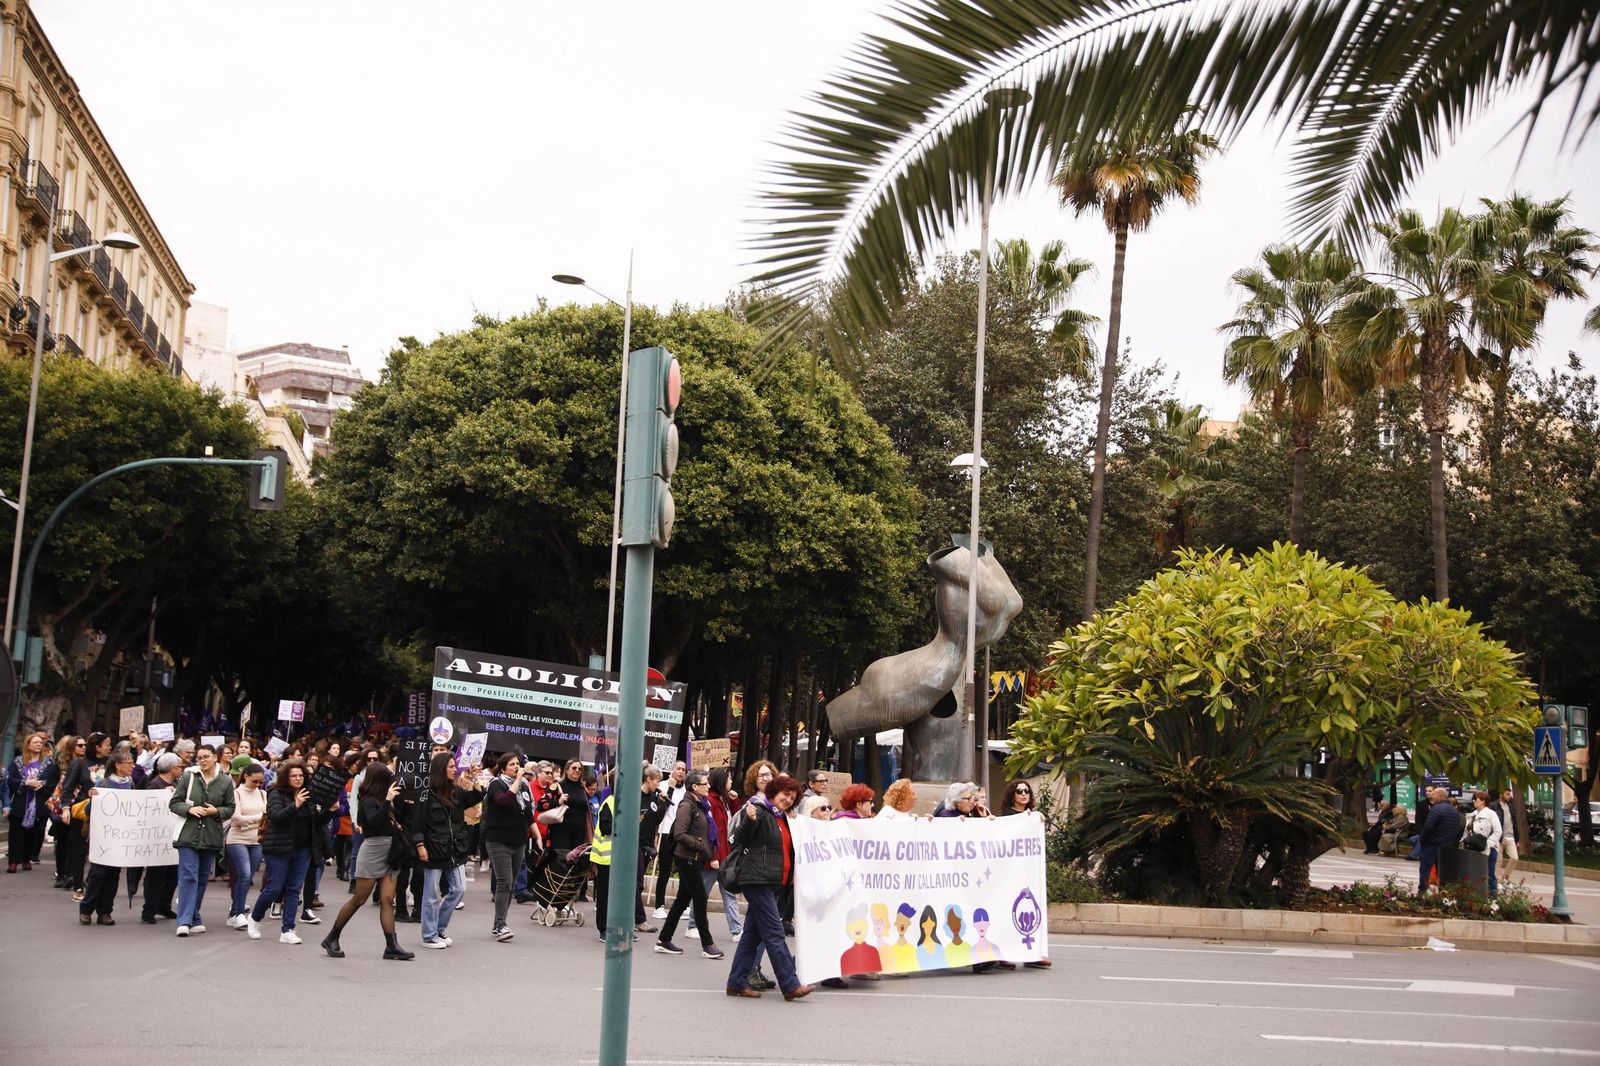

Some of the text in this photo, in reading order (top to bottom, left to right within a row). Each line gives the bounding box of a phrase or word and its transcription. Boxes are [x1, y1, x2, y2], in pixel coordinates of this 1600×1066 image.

[445, 658, 683, 702] ABOLICIN
[436, 681, 467, 692] Género
[477, 687, 534, 701] Prostitución
[543, 696, 593, 709] Pornografía
[647, 711, 678, 722] alquiler
[447, 704, 456, 712] NO
[456, 705, 480, 715] LUCHAS
[481, 709, 507, 719] CONTRA
[507, 712, 528, 722] TODAS
[528, 715, 541, 723] LAS
[541, 717, 577, 728] VIOLENCIAS
[577, 721, 596, 731] HACIA
[596, 724, 609, 733] LAS
[485, 722, 505, 732] ERES
[505, 725, 530, 735] PARTE
[530, 728, 545, 737] DEL
[545, 730, 584, 743] PROBLEMA
[405, 740, 416, 750] SI
[418, 742, 428, 751] TE
[419, 752, 425, 760] A
[398, 761, 428, 773] NO TE
[398, 776, 407, 789] A
[803, 835, 832, 864] MÁS
[895, 841, 939, 861] CONTRA
[943, 840, 977, 860] LAS
[980, 837, 1042, 859] MUJERES
[904, 874, 916, 890] NI
[917, 872, 969, 890] CALLAMOS
